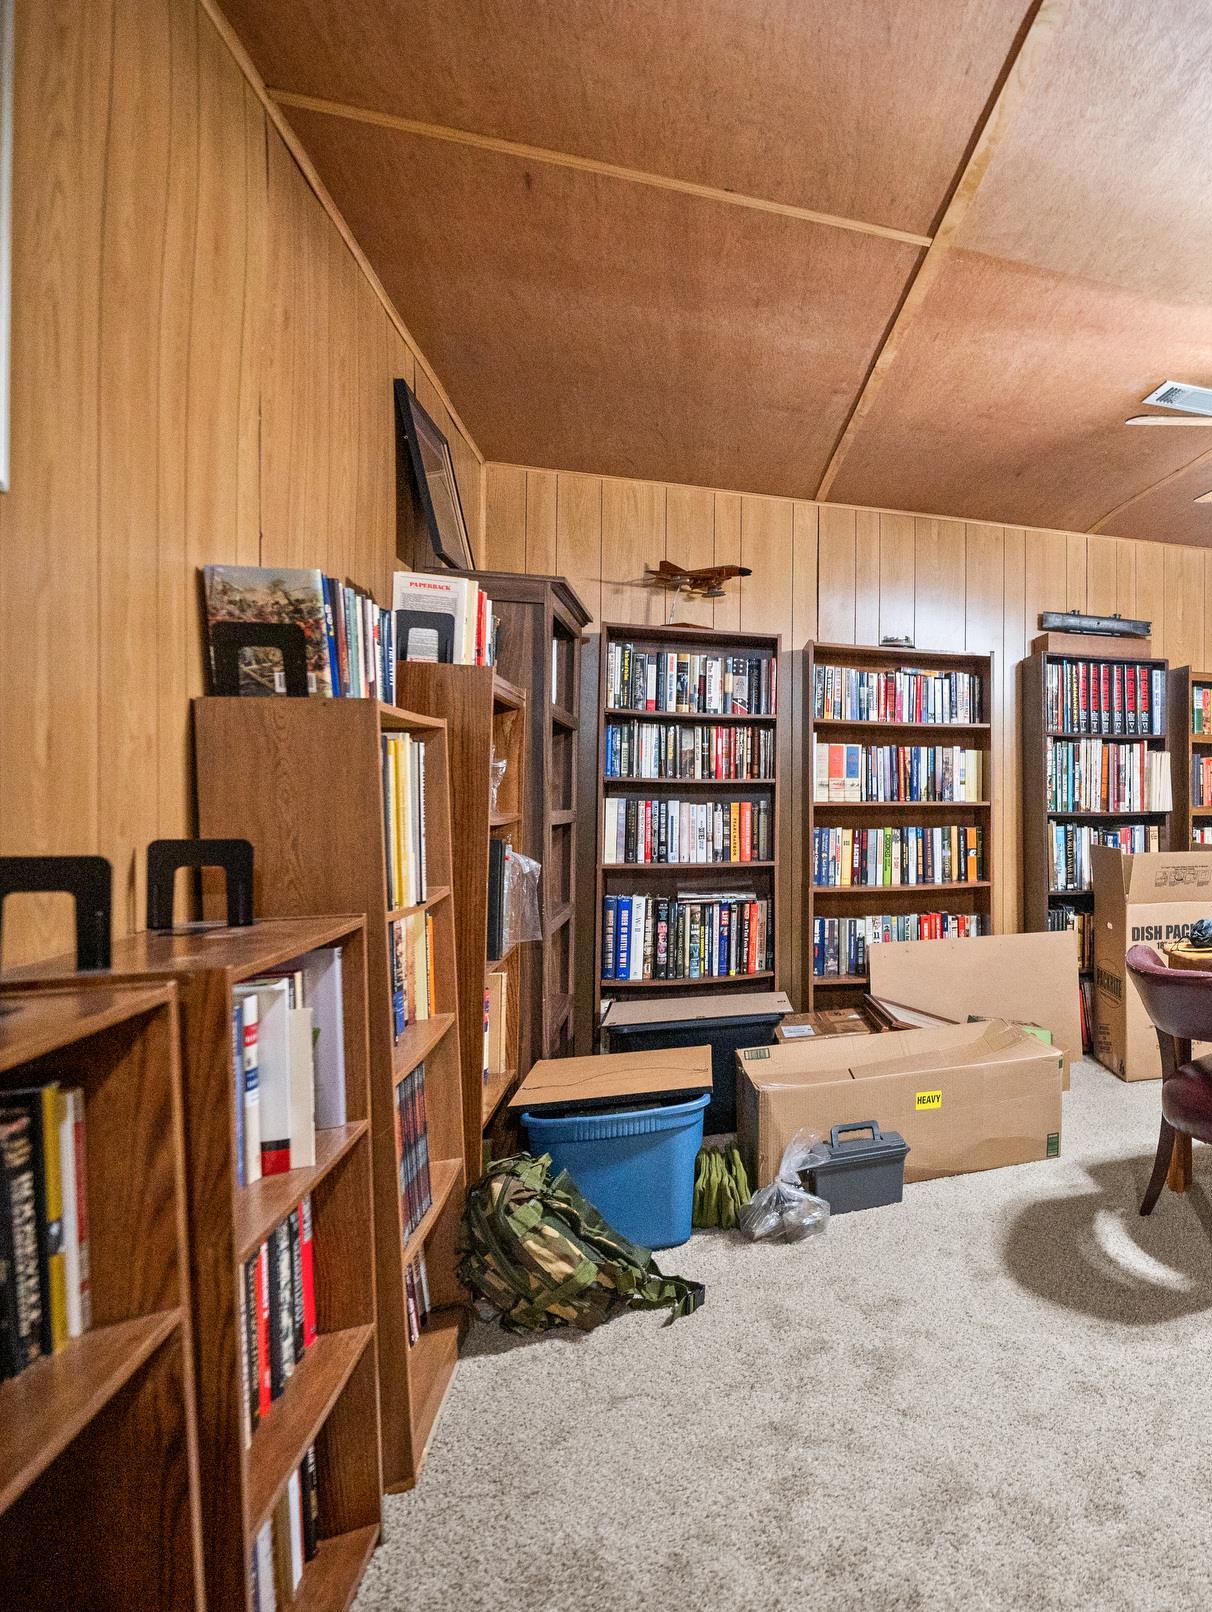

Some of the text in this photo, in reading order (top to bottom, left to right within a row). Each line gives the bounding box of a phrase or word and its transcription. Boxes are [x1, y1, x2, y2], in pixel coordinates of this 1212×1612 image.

[409, 581, 451, 591] PAPERBACK
[1131, 925, 1163, 941] DISH
[916, 1094, 941, 1105] HEAVY
